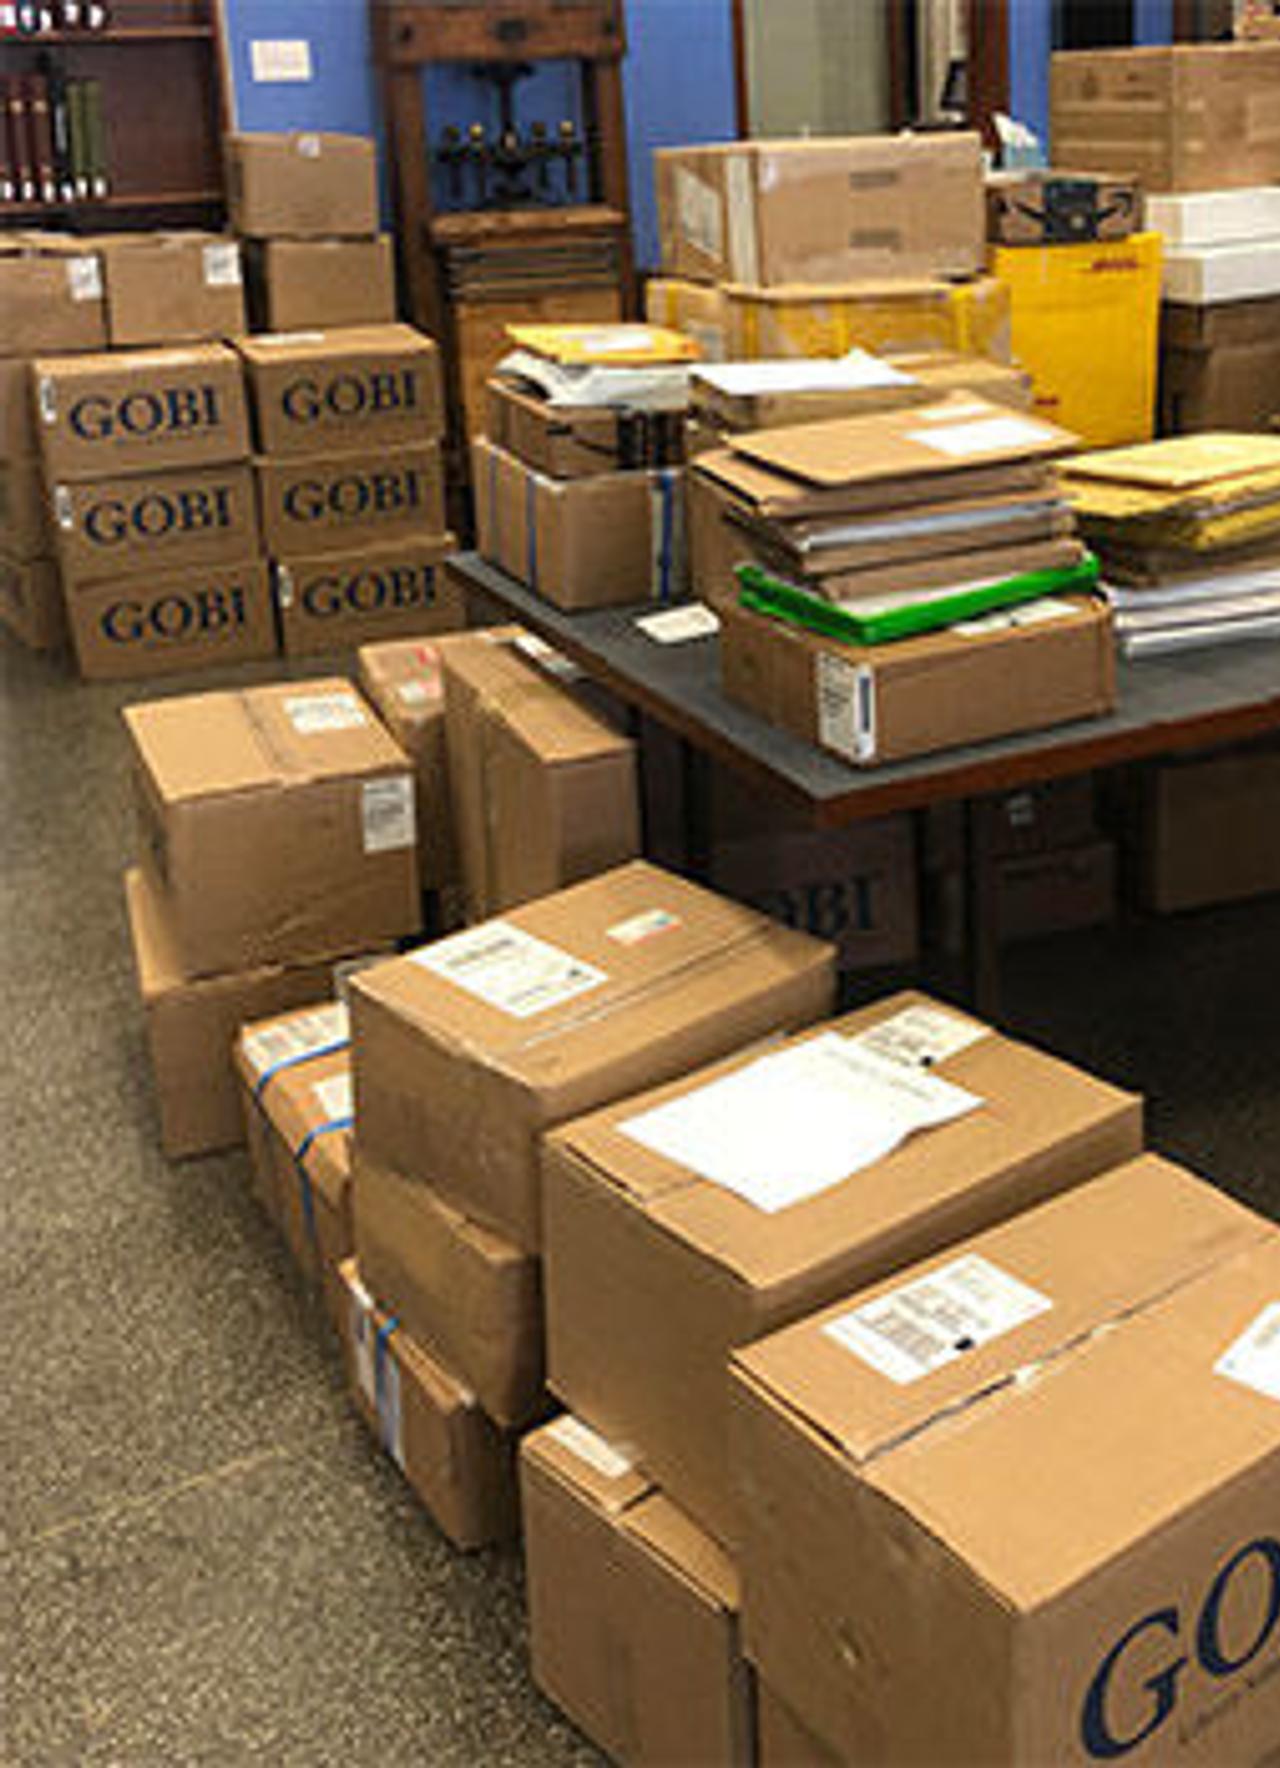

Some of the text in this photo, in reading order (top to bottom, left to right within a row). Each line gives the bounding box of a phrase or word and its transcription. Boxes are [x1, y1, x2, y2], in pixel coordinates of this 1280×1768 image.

[69, 384, 221, 440] GOBI
[281, 370, 417, 424] GOBI
[84, 487, 231, 545] GOBI
[282, 470, 420, 523] GOBI
[101, 585, 246, 642] GOBI
[302, 565, 438, 619] GOBI
